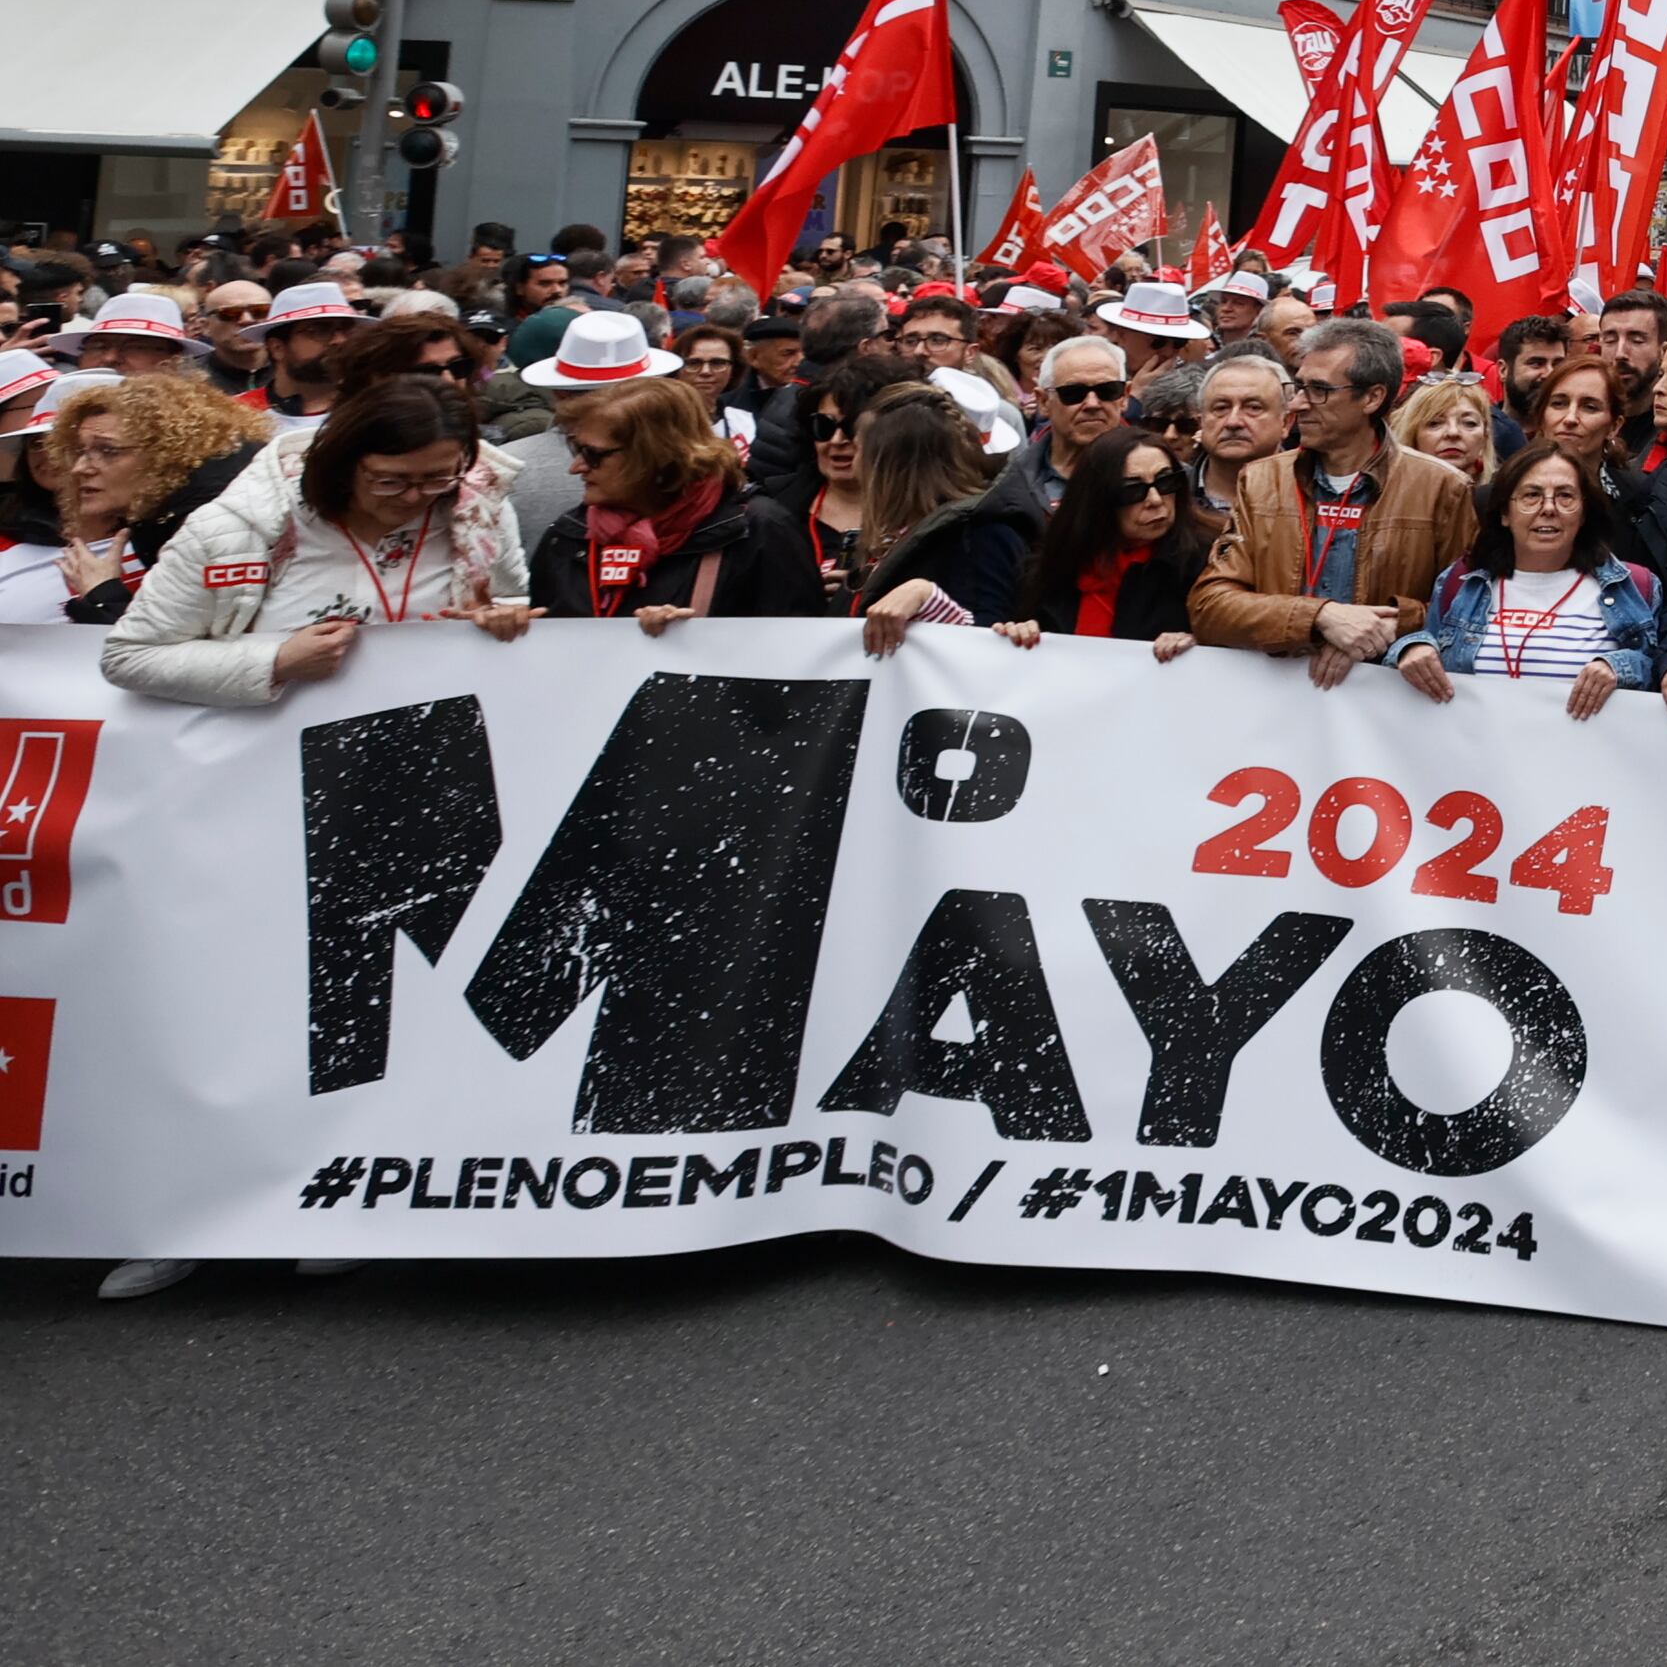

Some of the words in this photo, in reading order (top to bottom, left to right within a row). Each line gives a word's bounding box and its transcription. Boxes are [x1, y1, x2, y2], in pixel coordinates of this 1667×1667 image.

[1318, 505, 1362, 518] CCOO
[601, 548, 640, 563] COO
[1193, 766, 1613, 915] 2024
[299, 1138, 932, 1211] #PLENOEMPLEO
[1020, 1165, 1538, 1261] #1MAYO2024
